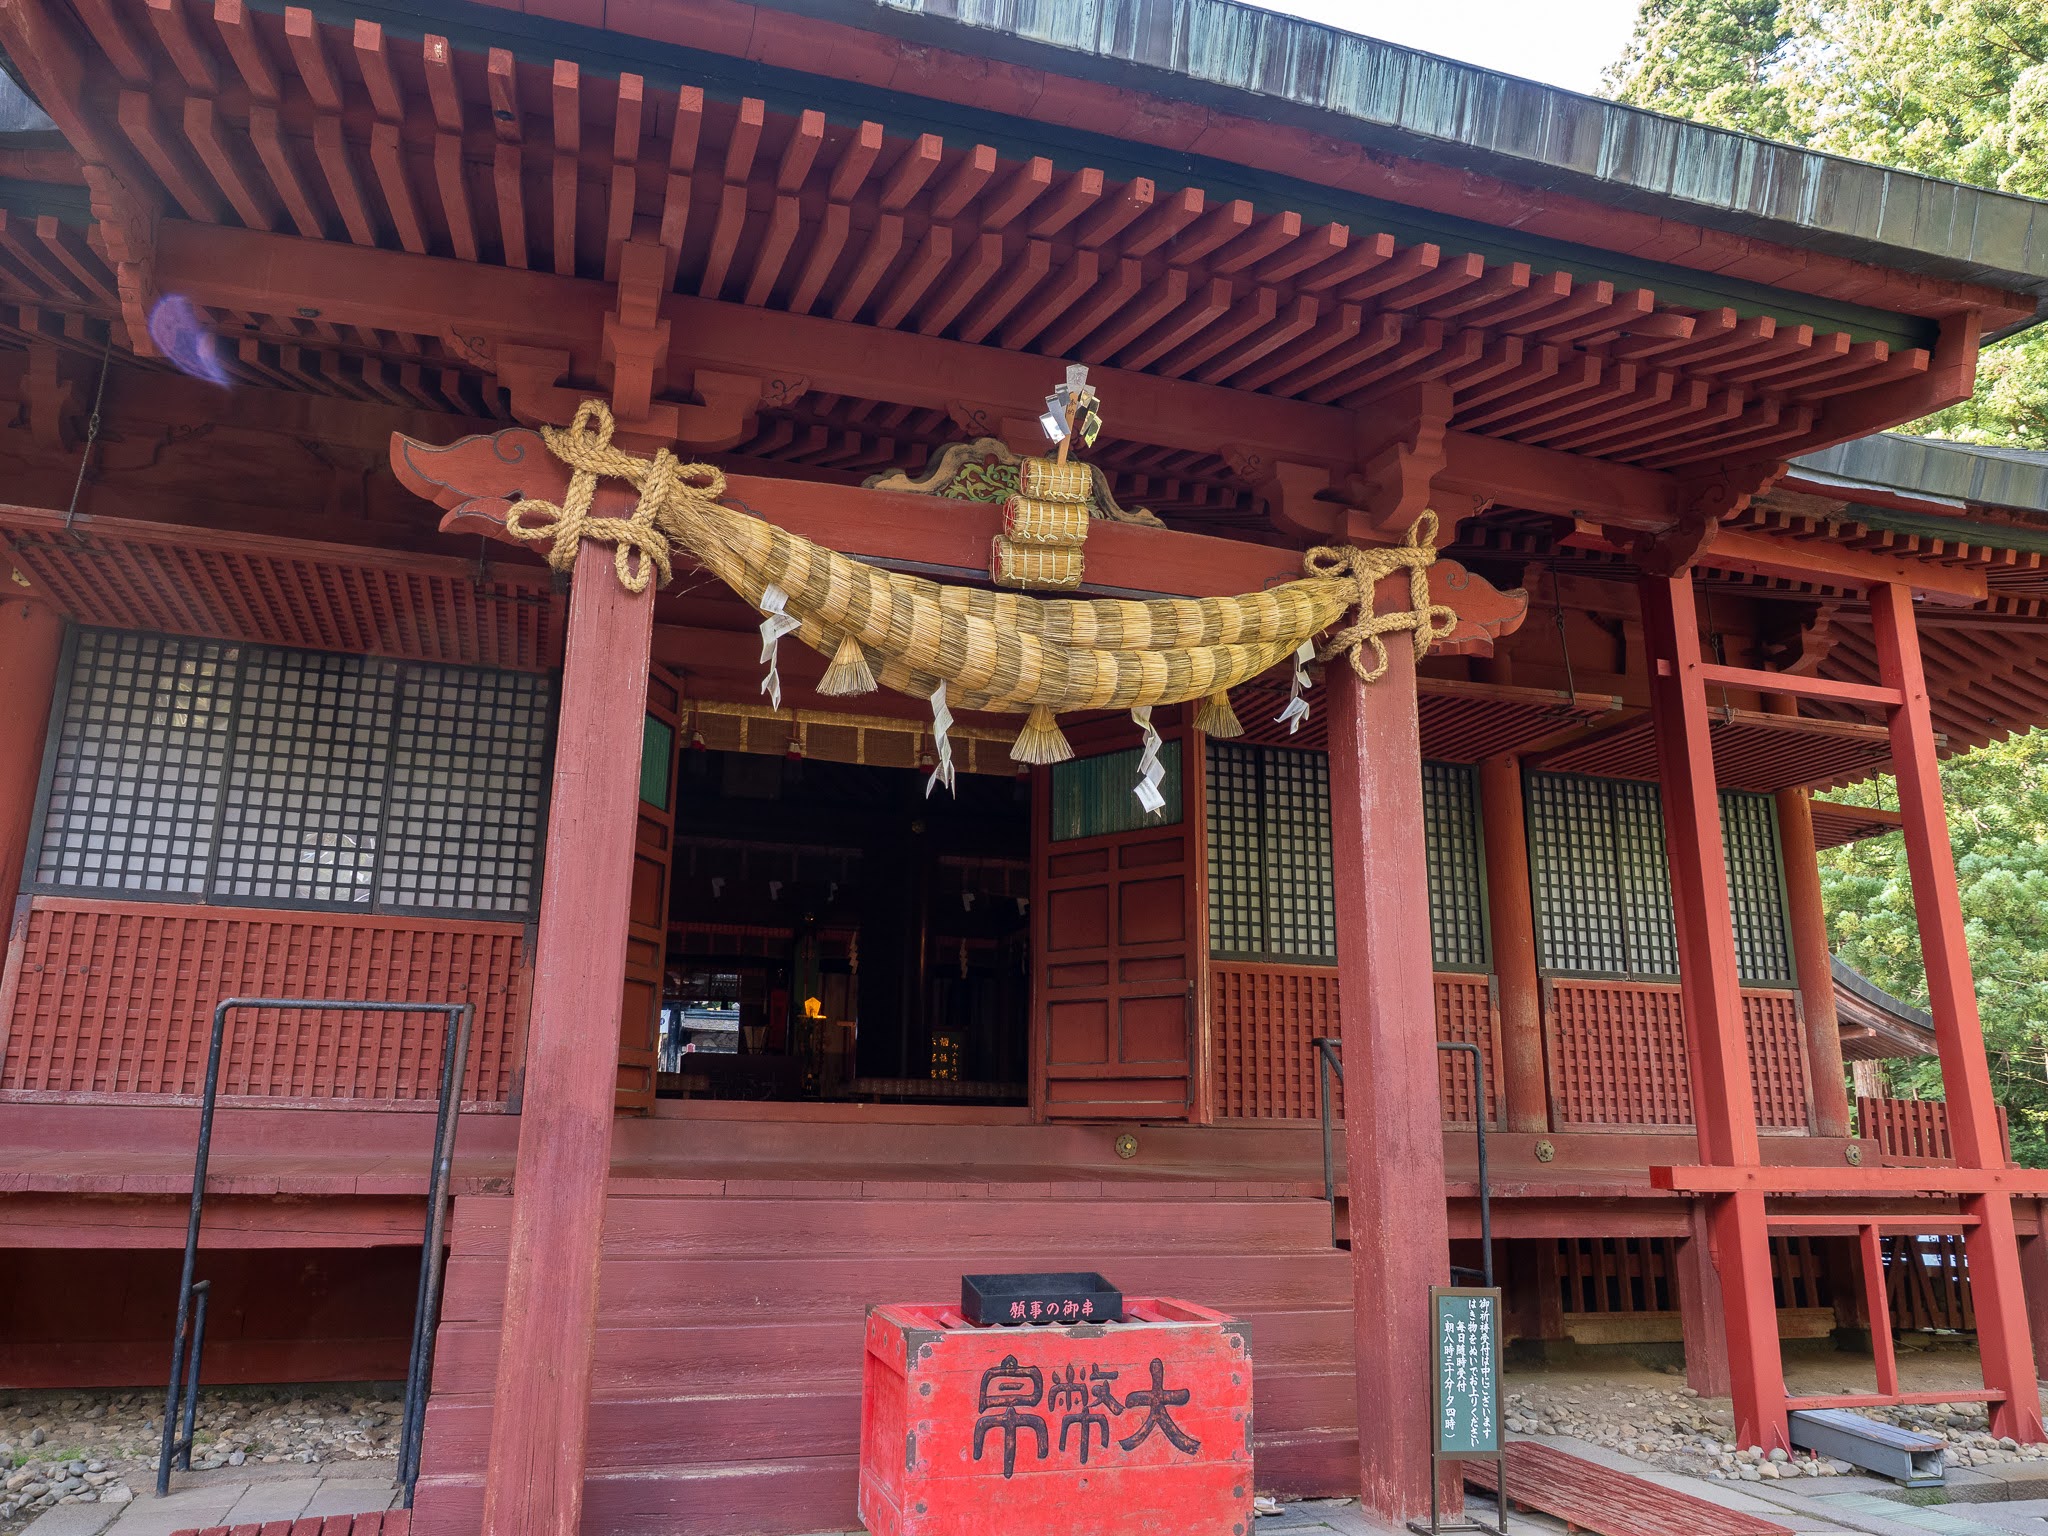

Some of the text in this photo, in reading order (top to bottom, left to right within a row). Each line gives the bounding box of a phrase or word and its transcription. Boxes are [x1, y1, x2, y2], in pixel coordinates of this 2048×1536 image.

[1468, 1299, 1480, 1447] はき物をぬいでお上りください
